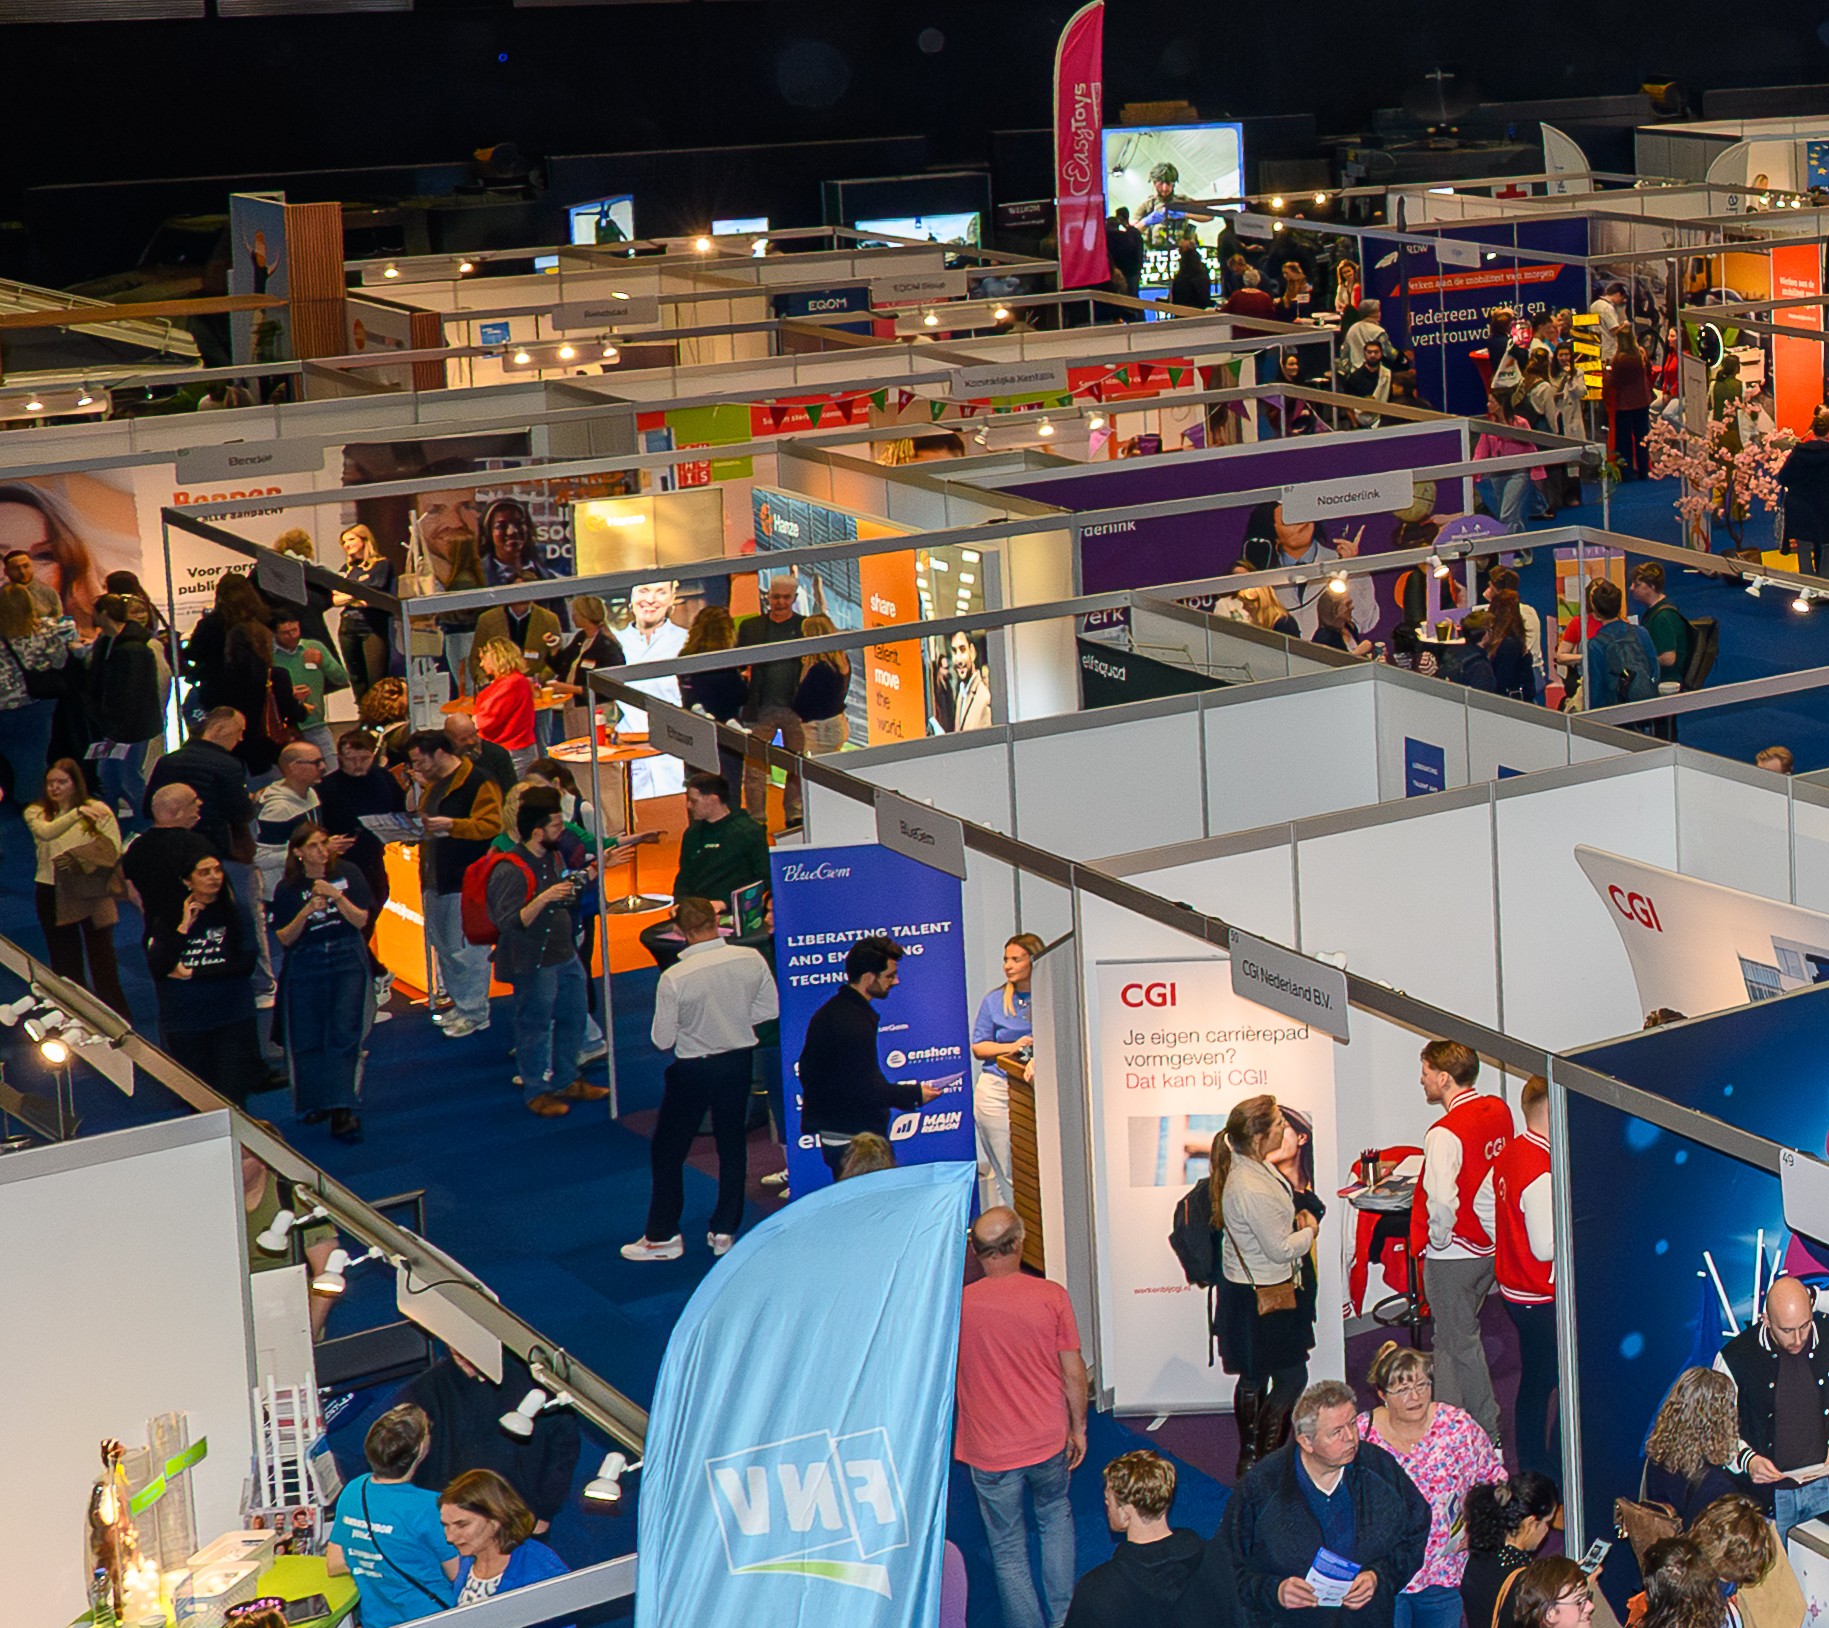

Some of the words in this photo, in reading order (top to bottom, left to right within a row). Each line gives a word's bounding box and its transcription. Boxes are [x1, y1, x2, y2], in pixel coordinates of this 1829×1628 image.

[1406, 243, 1429, 255] RDW
[808, 297, 848, 312] EQOM
[1410, 307, 1478, 328] Iedereen
[1316, 487, 1381, 507] Noorderlink
[773, 513, 800, 538] Hanze
[187, 565, 221, 578] Voor
[870, 593, 897, 618] share
[874, 667, 901, 691] move
[876, 691, 893, 711] the
[876, 714, 905, 740] world.
[782, 862, 851, 883] BlueGem
[1607, 883, 1663, 932] CGI
[786, 927, 888, 948] LIBERATING
[891, 921, 952, 938] TALENT
[788, 952, 823, 968] AND
[1242, 957, 1260, 981] CGI
[1260, 966, 1312, 1003] Nederland
[1313, 987, 1334, 1012] B.V.
[1120, 982, 1178, 1009] CGI
[1123, 1028, 1146, 1046] Je
[1150, 1027, 1200, 1047] eigen
[1205, 1023, 1310, 1046] carrièrepad
[907, 1046, 961, 1060] enshore
[1124, 1047, 1237, 1072] vormgeven?
[1125, 1071, 1159, 1090] Dat
[1162, 1071, 1197, 1088] kan
[1202, 1069, 1222, 1090] bij
[1228, 1068, 1268, 1087] CGI!
[923, 1112, 963, 1126] MAIN
[1781, 1150, 1797, 1169] 49
